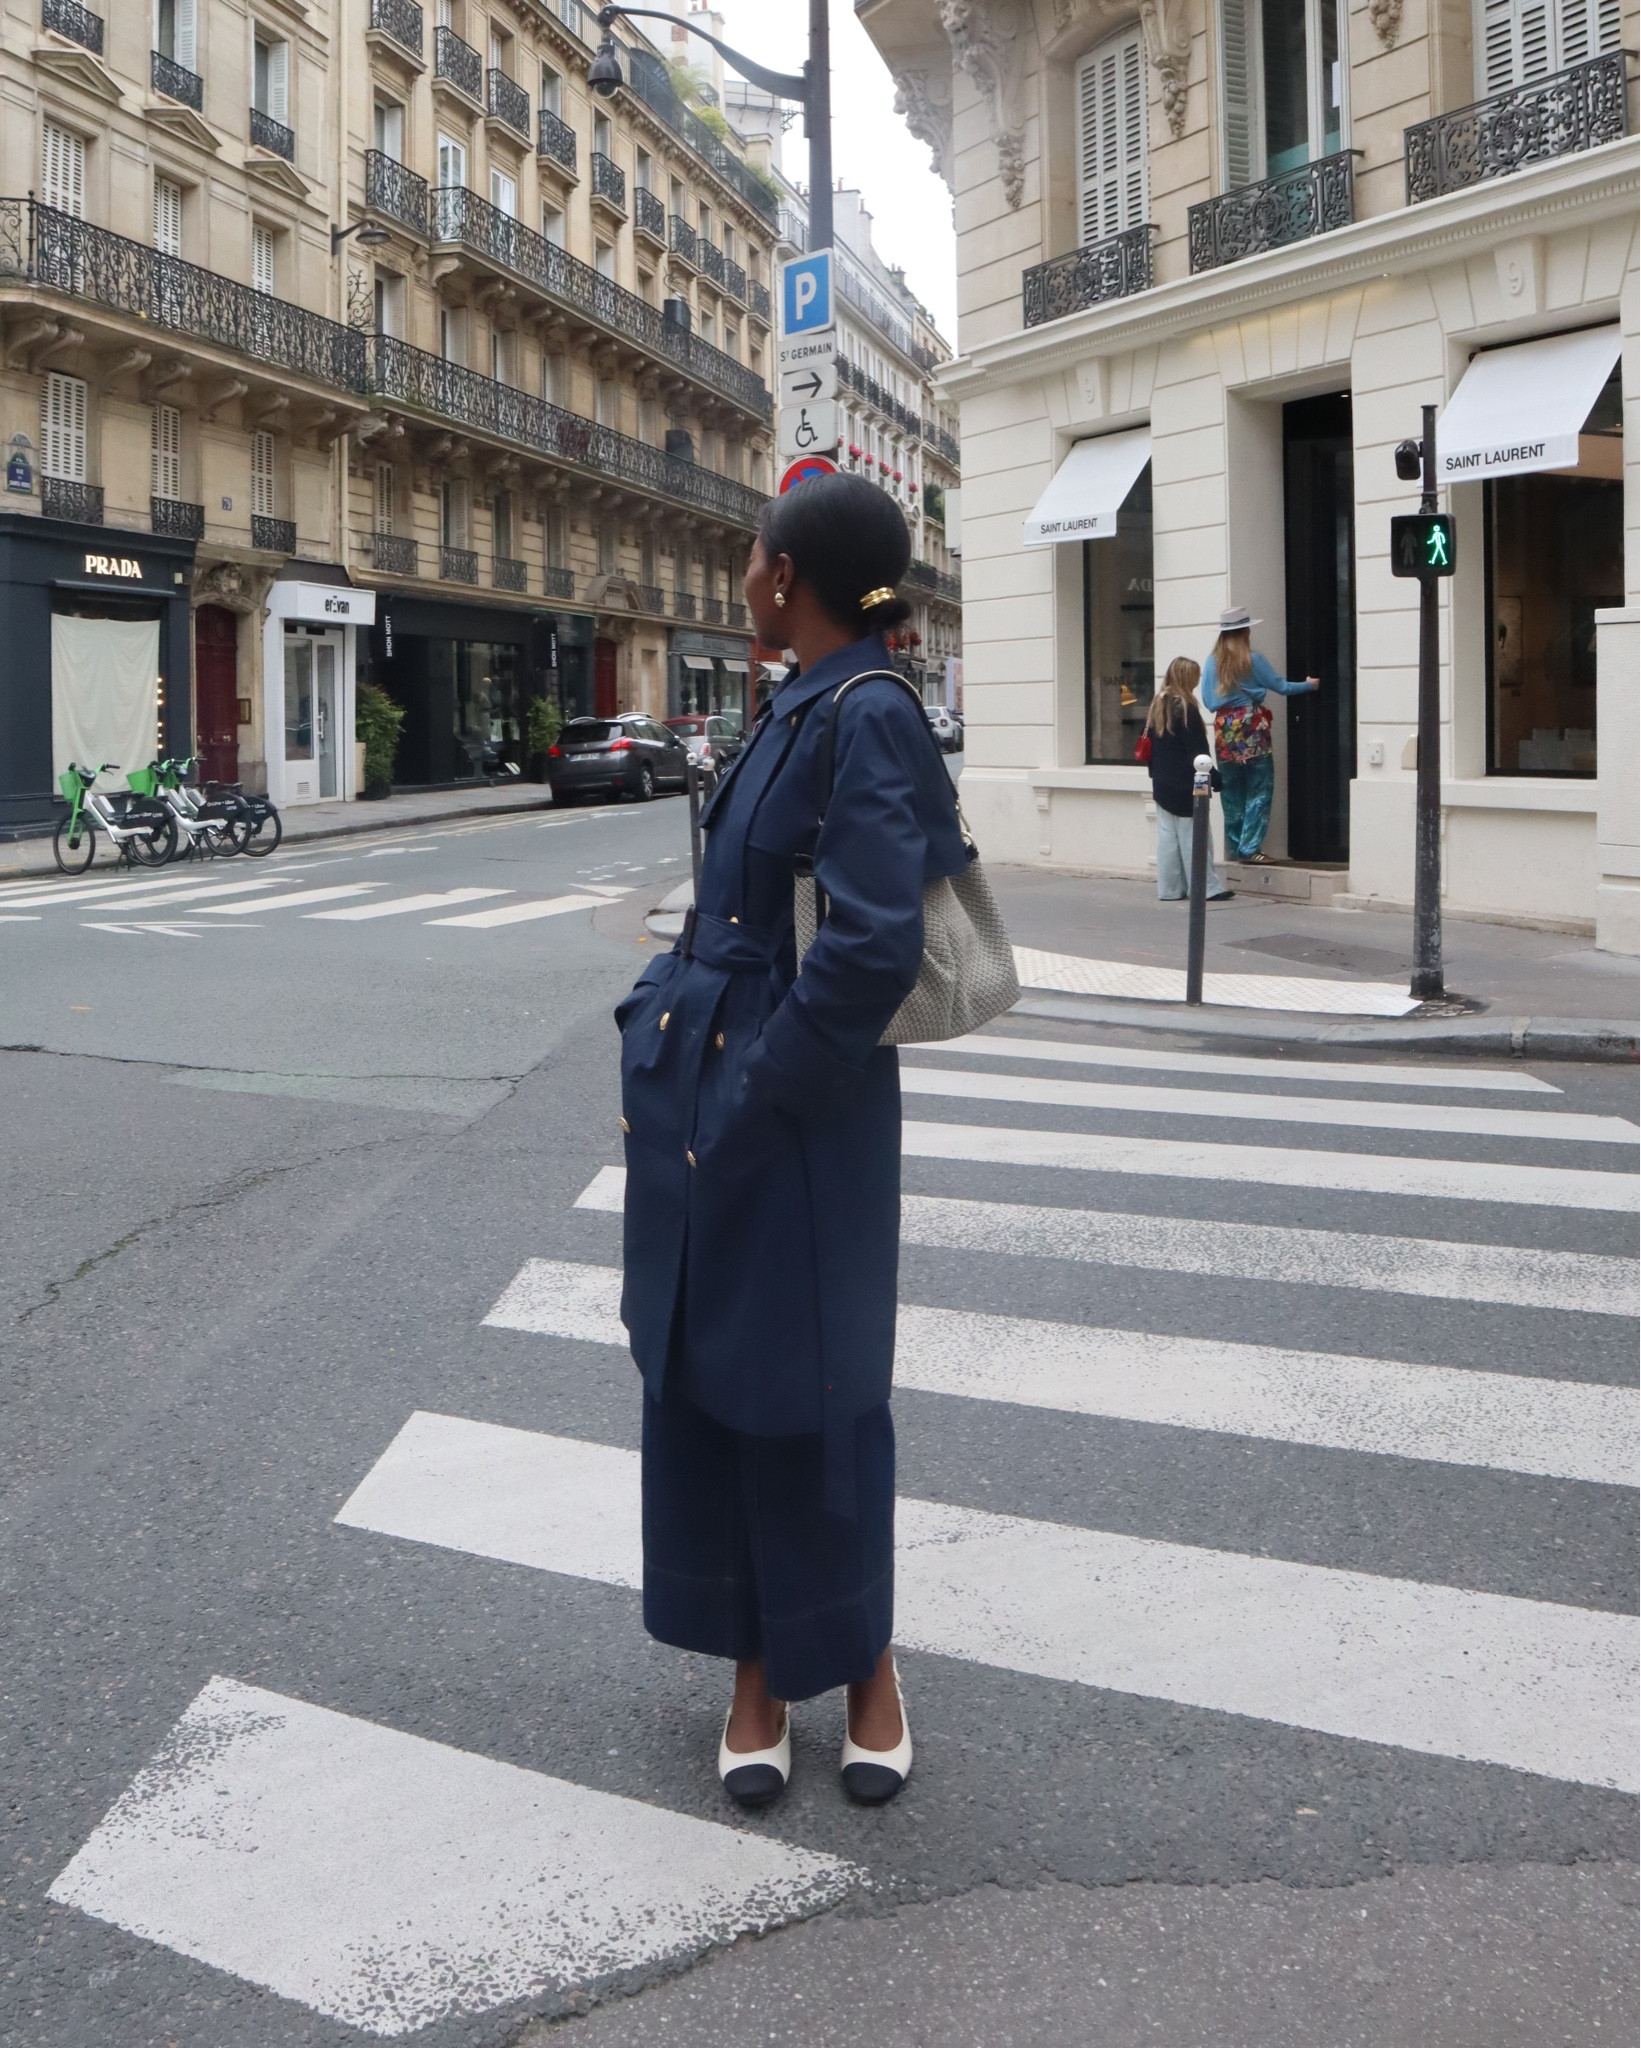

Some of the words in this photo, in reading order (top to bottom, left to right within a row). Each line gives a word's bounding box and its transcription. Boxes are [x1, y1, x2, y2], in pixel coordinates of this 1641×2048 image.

[795, 271, 817, 321] P
[791, 342, 832, 361] GERMAIN
[1445, 453, 1482, 471] SAINT
[1484, 443, 1546, 466] LAURENT
[1040, 522, 1062, 535] SAINT
[1062, 517, 1098, 532] LAURENT
[85, 554, 143, 579] PRADA
